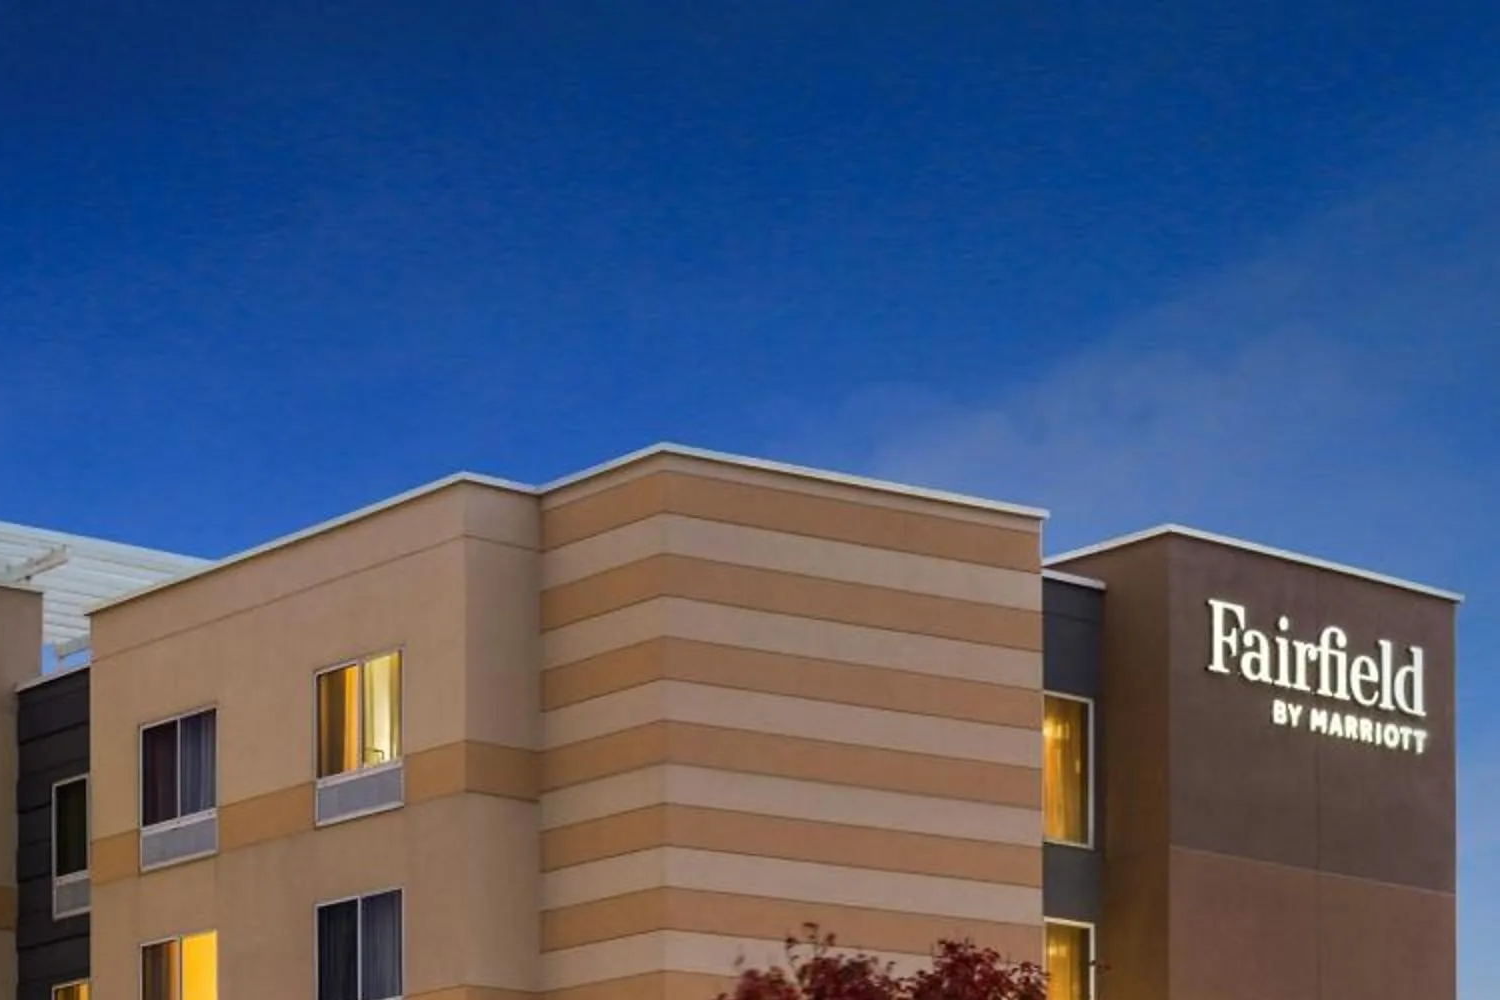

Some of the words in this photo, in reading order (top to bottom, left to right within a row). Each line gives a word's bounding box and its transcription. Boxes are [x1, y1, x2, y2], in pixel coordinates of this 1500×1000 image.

[1208, 599, 1426, 717] Fairfield
[1273, 700, 1302, 728] BY
[1310, 708, 1427, 754] MARRIOTT
